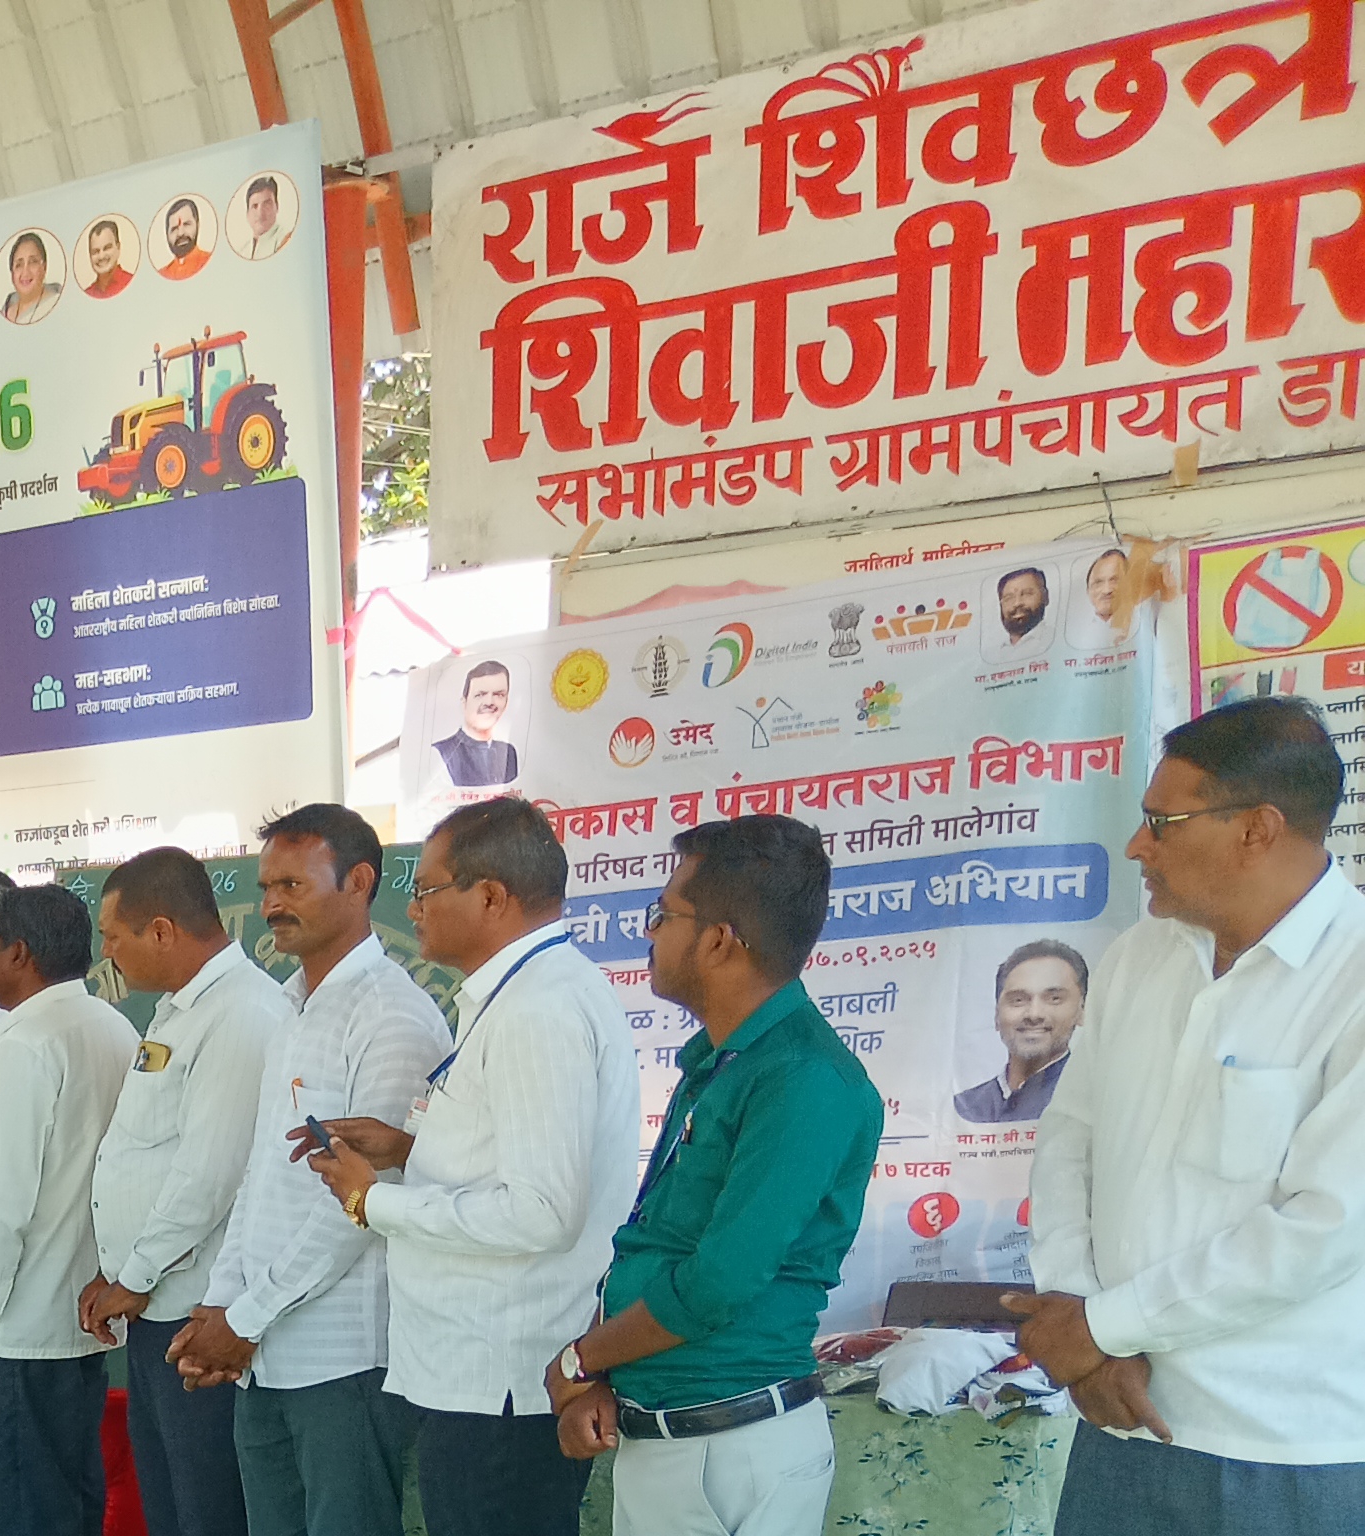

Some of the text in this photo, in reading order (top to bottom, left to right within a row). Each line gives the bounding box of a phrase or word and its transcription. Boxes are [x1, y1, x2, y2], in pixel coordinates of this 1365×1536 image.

[481, 0, 1359, 283] राजे शिवछत्र
[480, 163, 1365, 462] शिवाजी महार
[536, 349, 1365, 526] सभामंडप ग्रामपंचायत डा
[20, 473, 58, 499] प्रदर्शन
[844, 546, 914, 572] जनहितार्थ
[70, 589, 109, 613] महिला
[113, 578, 156, 607] शेतकरी
[754, 640, 818, 659] Digital India
[887, 635, 956, 655] पंचायती राज
[669, 719, 715, 746] उमेद
[669, 792, 702, 827] व
[715, 755, 955, 816] पंचायतराज
[968, 734, 1125, 791] विभाग
[844, 803, 1040, 855] समिती मालेगांव
[574, 852, 648, 884] परिषद
[926, 859, 1088, 905] अभियान
[819, 982, 899, 1018] डाबली
[885, 1161, 951, 1178] ७ घटक
